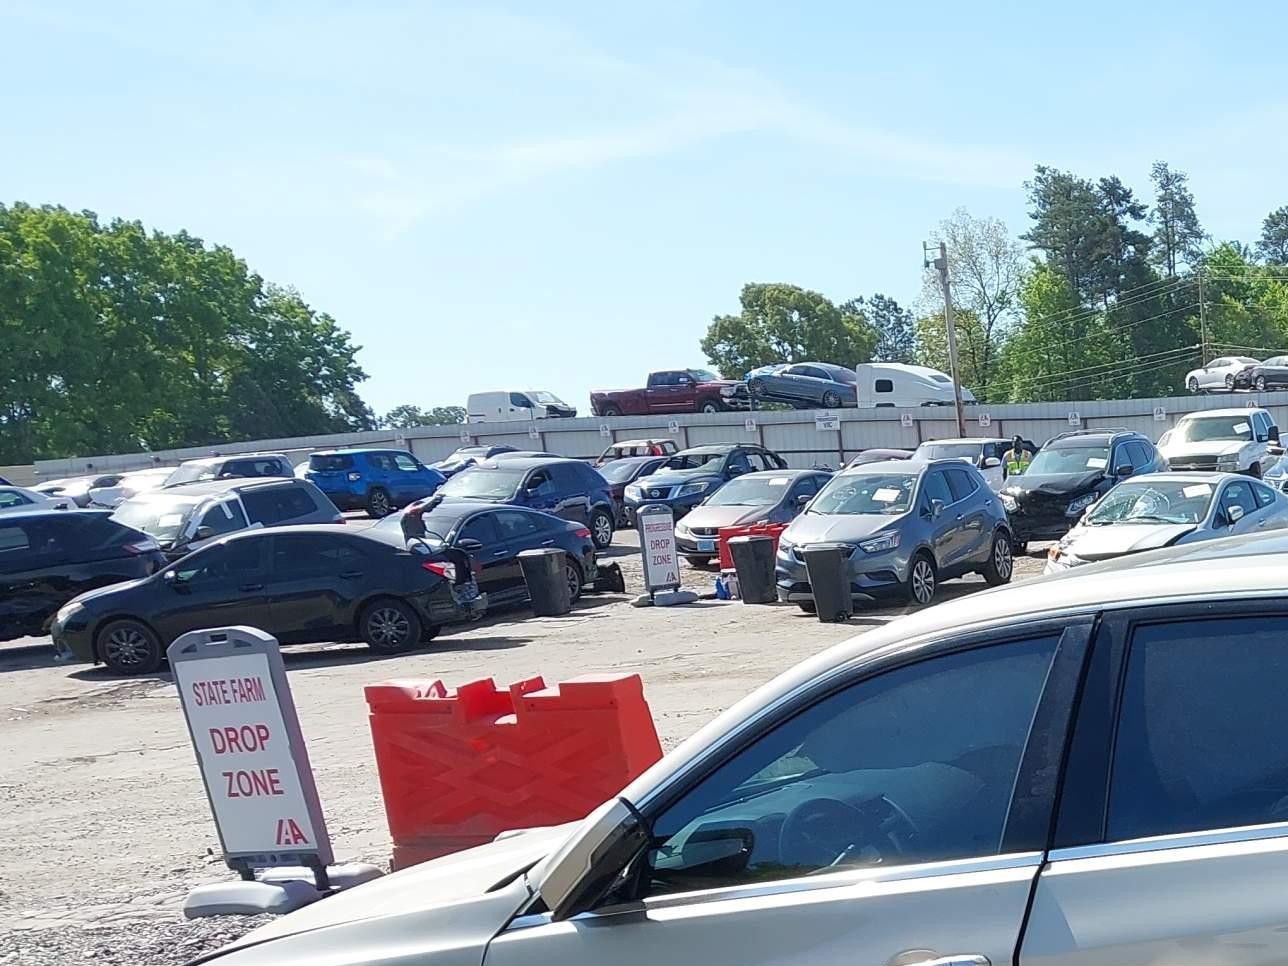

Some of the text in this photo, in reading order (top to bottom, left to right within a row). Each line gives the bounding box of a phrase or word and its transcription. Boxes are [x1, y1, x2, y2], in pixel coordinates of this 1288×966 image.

[650, 539, 670, 550] DROP
[653, 554, 672, 566] ZONE
[192, 677, 266, 706] STATE FARM
[209, 724, 270, 754] DROP
[222, 769, 284, 798] ZONE
